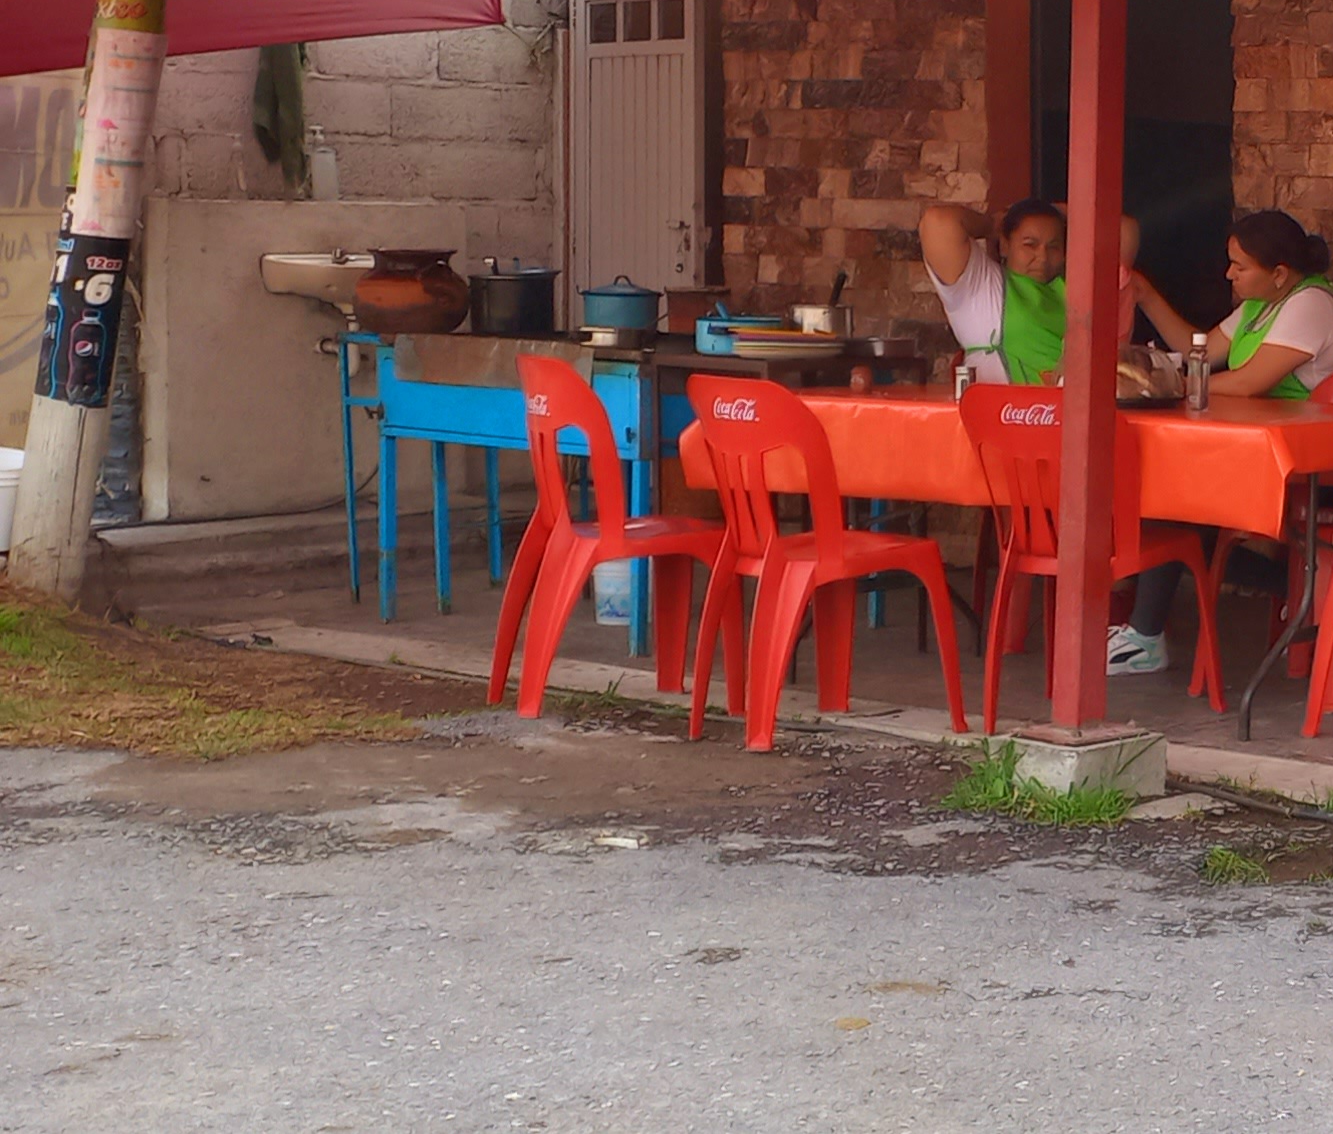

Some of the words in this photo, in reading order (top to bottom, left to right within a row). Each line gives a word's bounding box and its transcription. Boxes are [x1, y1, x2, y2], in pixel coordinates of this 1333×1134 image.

[84, 273, 115, 307] 6
[714, 396, 757, 421] Coca-Cola
[1000, 402, 1058, 426] Coca-Cola
